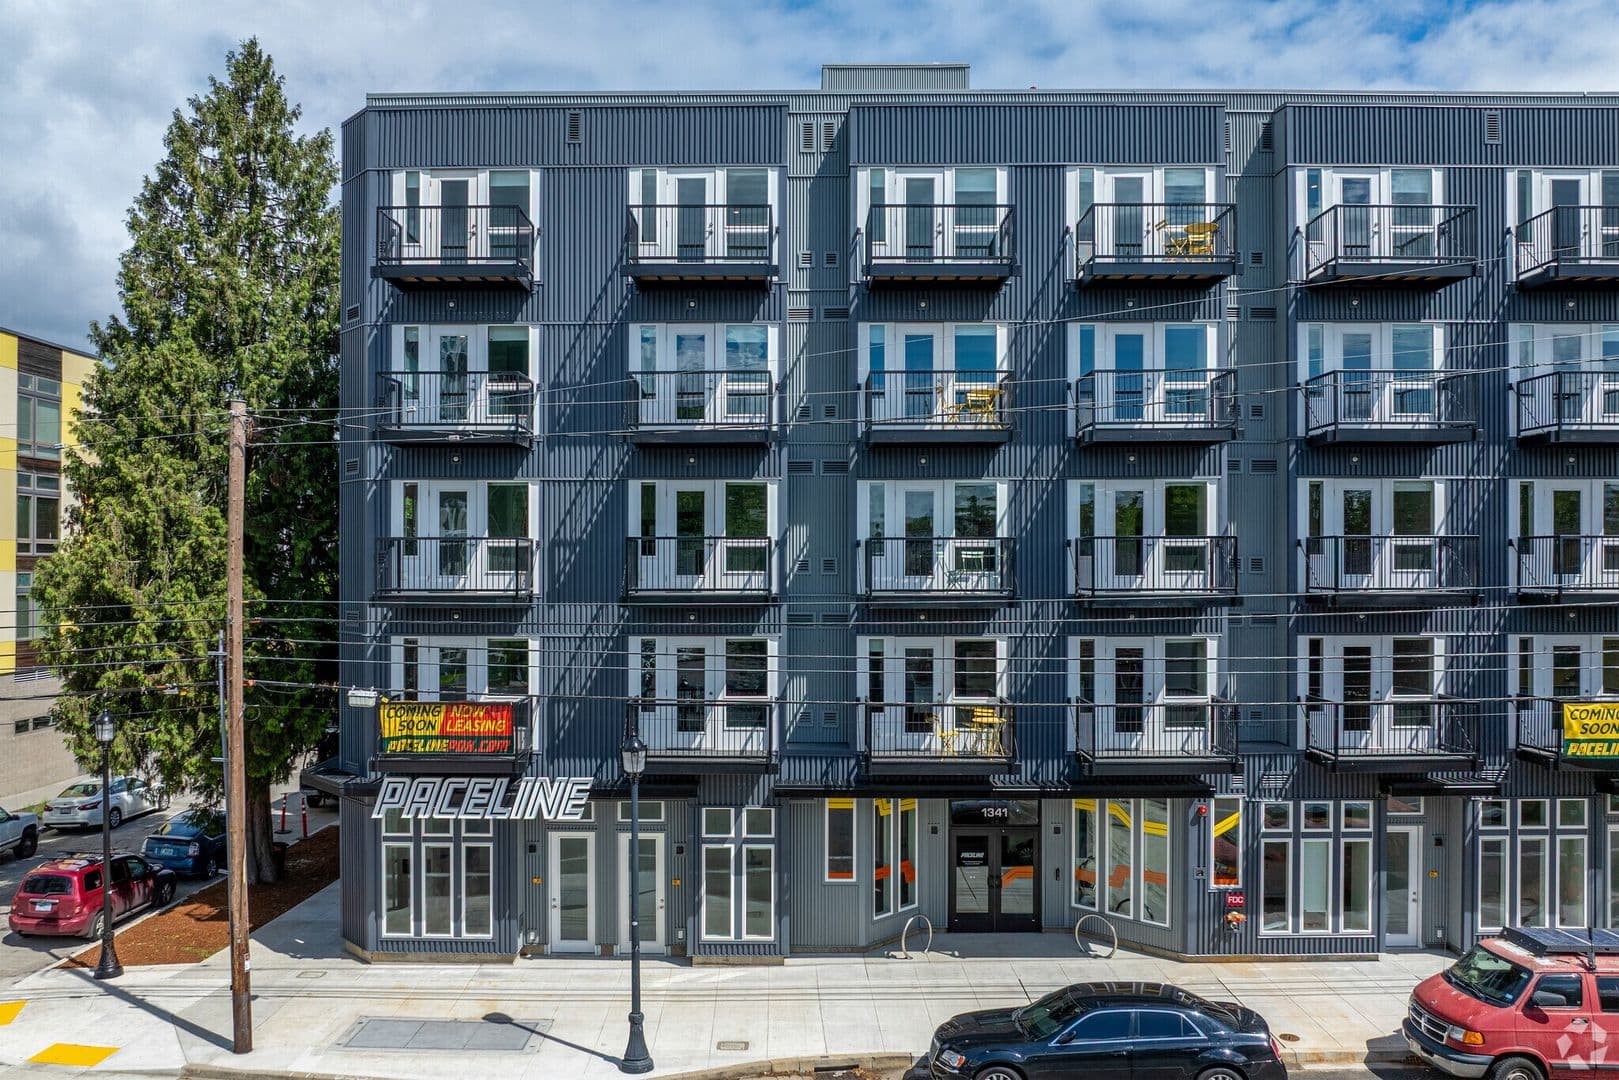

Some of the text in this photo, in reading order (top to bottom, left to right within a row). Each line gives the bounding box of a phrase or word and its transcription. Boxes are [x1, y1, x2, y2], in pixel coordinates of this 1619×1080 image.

[386, 705, 441, 719] COMING
[450, 705, 486, 718] NOW
[1570, 708, 1619, 721] COMIN
[398, 720, 437, 732] SOON
[446, 720, 506, 732] LEASING
[1567, 742, 1619, 756] PACELI
[371, 777, 594, 820] PACELINE
[981, 807, 1008, 818] 1341
[1227, 895, 1244, 904] FDC
